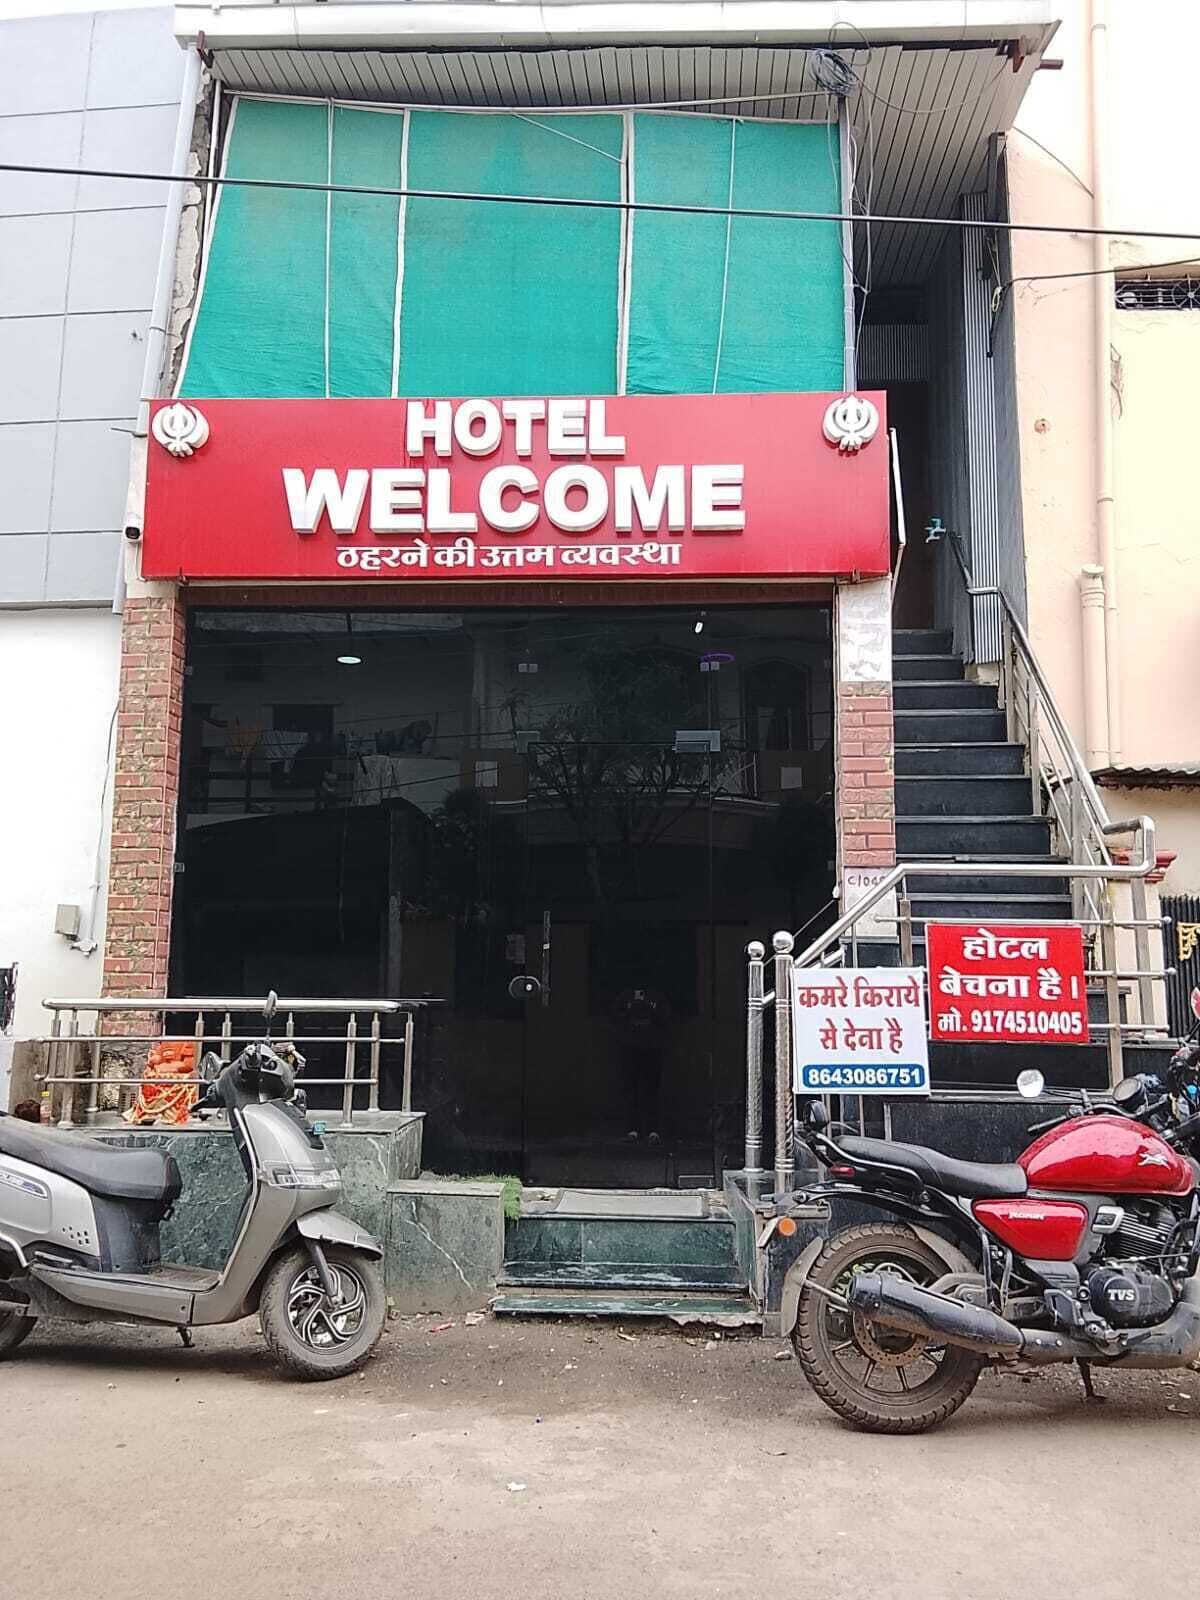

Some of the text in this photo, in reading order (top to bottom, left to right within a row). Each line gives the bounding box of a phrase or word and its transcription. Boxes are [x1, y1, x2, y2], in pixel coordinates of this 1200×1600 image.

[406, 399, 626, 457] HOTEL
[282, 464, 746, 534] WELCOME
[336, 537, 682, 571] ठहरने की उत्तम व्यवस्था
[960, 927, 1050, 961] होटल
[797, 975, 920, 1008] कमरे किराये
[938, 965, 1031, 998] बेचना
[819, 1018, 903, 1054] से देना है
[937, 1006, 1082, 1035] मो. 9174510405
[808, 1068, 921, 1085] 8643086751
[1108, 1288, 1134, 1301] TVS
